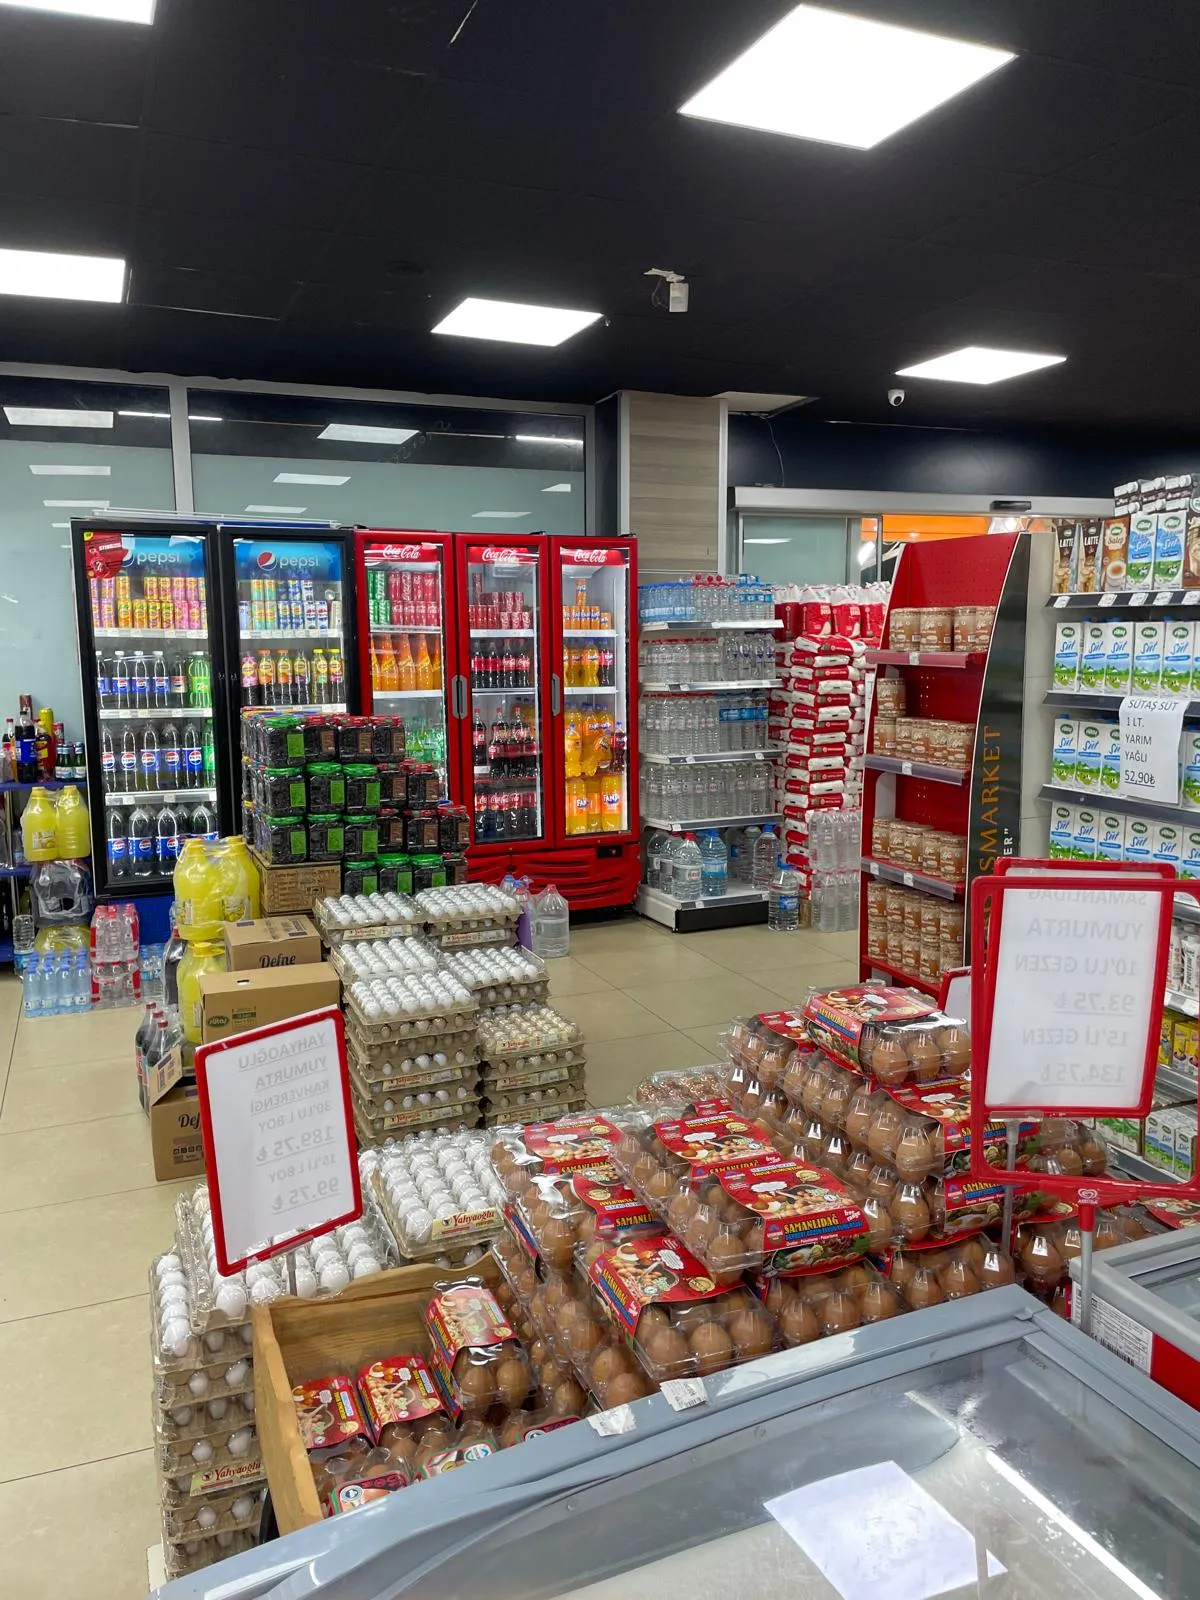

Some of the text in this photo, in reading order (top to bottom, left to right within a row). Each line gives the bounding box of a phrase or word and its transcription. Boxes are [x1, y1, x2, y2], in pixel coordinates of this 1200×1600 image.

[137, 552, 180, 566] pepsi
[280, 556, 319, 569] pepsi
[1125, 733, 1152, 746] YARIM
[1124, 749, 1148, 763] YAĞLI
[178, 1111, 200, 1130] Def
[452, 1210, 495, 1227] Yahyaoğlu
[784, 1213, 839, 1234] SAMANLIDAĞ
[215, 1461, 262, 1481] Yahyaoğlu
